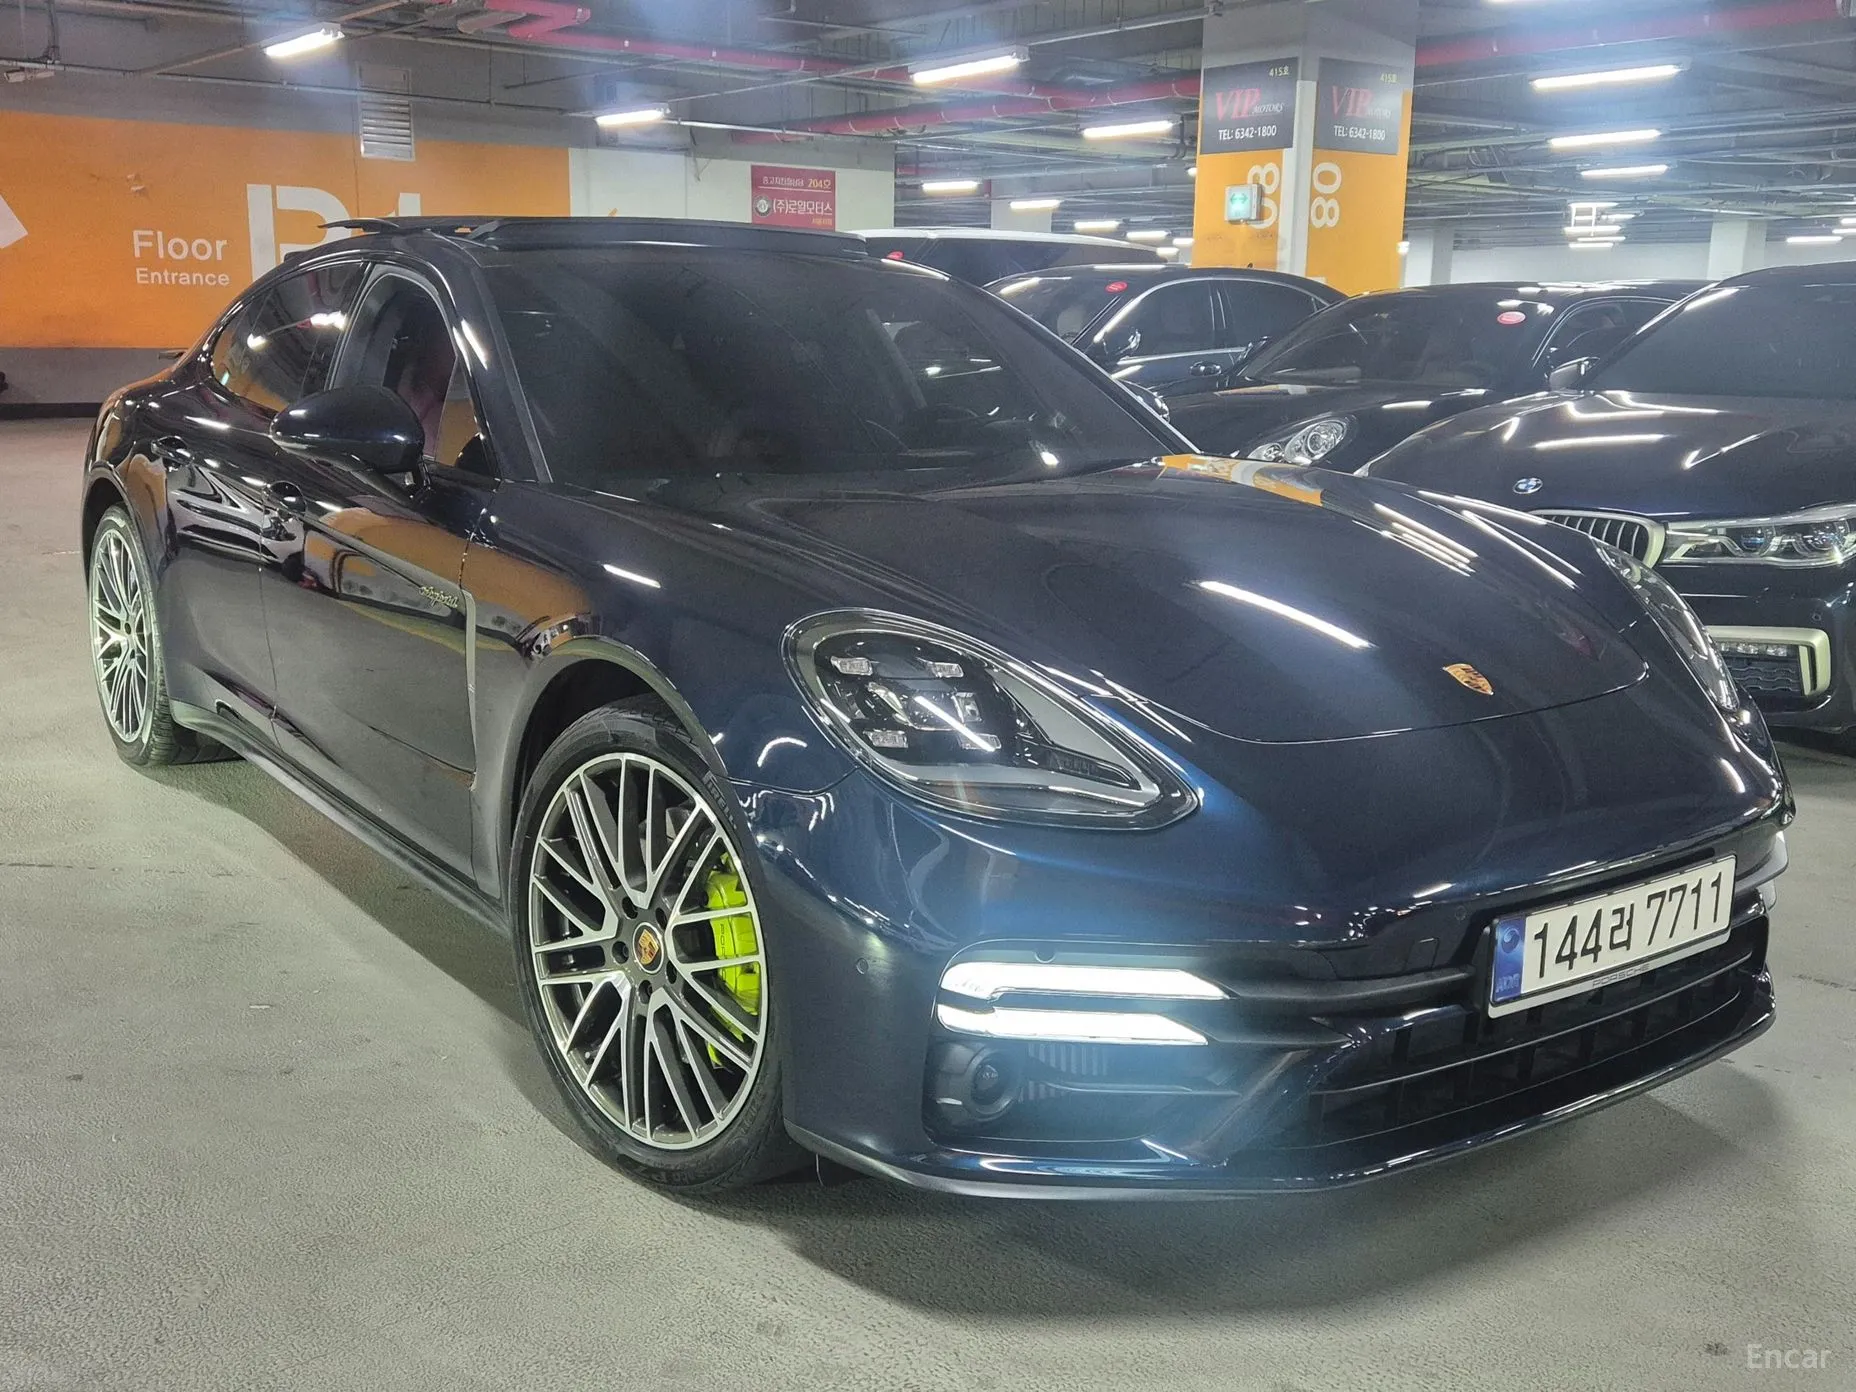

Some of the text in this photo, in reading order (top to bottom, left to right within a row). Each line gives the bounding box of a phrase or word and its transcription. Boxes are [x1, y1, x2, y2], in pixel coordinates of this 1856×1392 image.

[1216, 88, 1262, 121] VIP
[1332, 85, 1374, 119] VIP
[1218, 125, 1277, 140] TEL: 6342-1800
[1334, 125, 1386, 140] TEL: 6342-1800
[132, 229, 228, 261] Floor
[136, 267, 230, 286] Entrance
[1534, 871, 1722, 978] 144러 7711
[1592, 963, 1650, 989] PORSCHE
